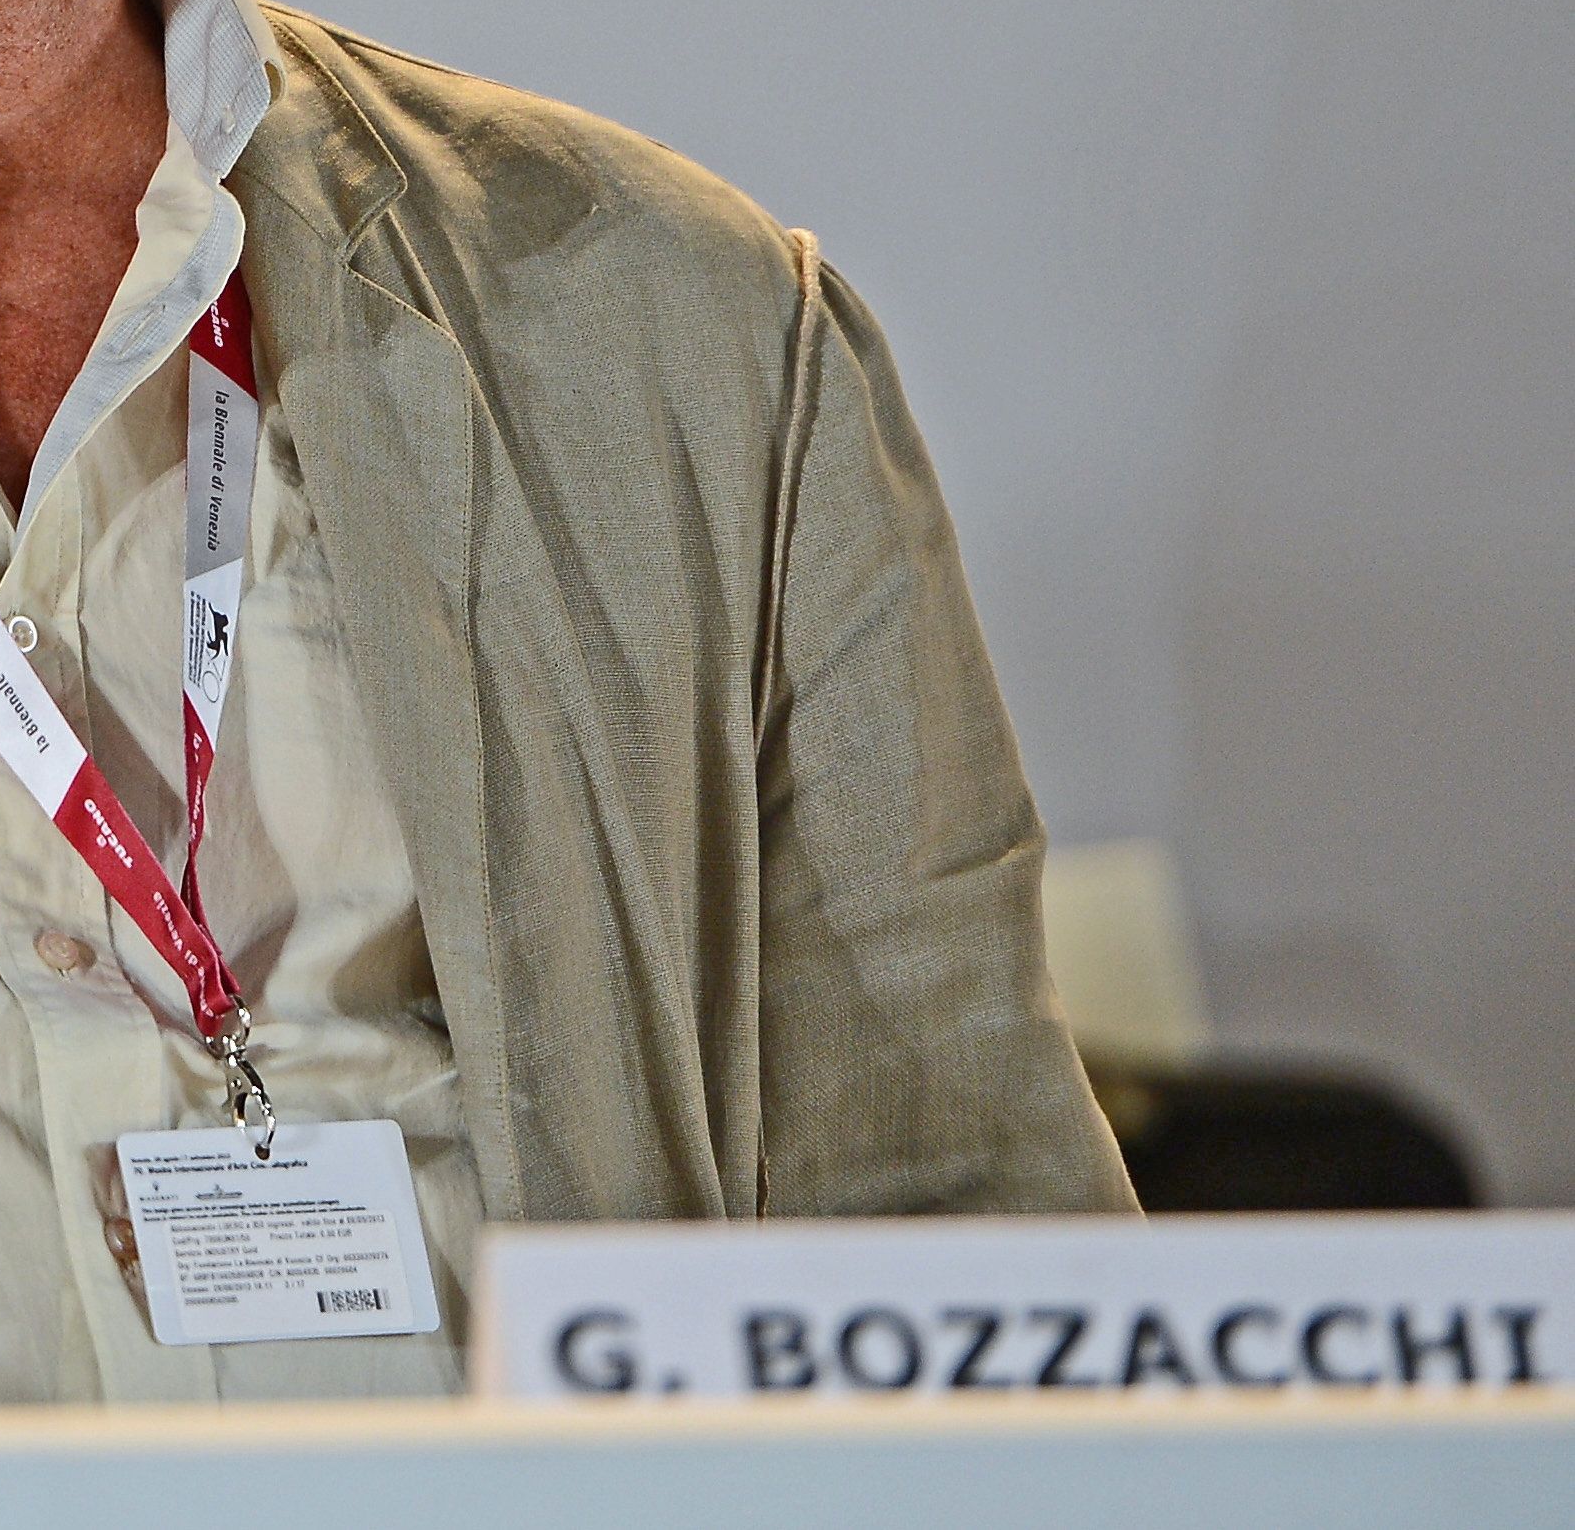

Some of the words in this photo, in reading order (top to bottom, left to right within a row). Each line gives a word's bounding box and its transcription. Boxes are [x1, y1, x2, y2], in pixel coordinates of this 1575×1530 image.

[211, 300, 224, 348] CANO
[216, 390, 230, 405] la
[213, 407, 229, 472] Biennale
[211, 475, 225, 492] di
[208, 496, 222, 551] Venezia
[37, 735, 50, 753] la
[84, 799, 133, 868] TUCANO
[153, 891, 183, 951] Venezia
[184, 949, 198, 966] di
[553, 1306, 686, 1394] G.
[741, 1302, 1551, 1390] BOZZACCHI
